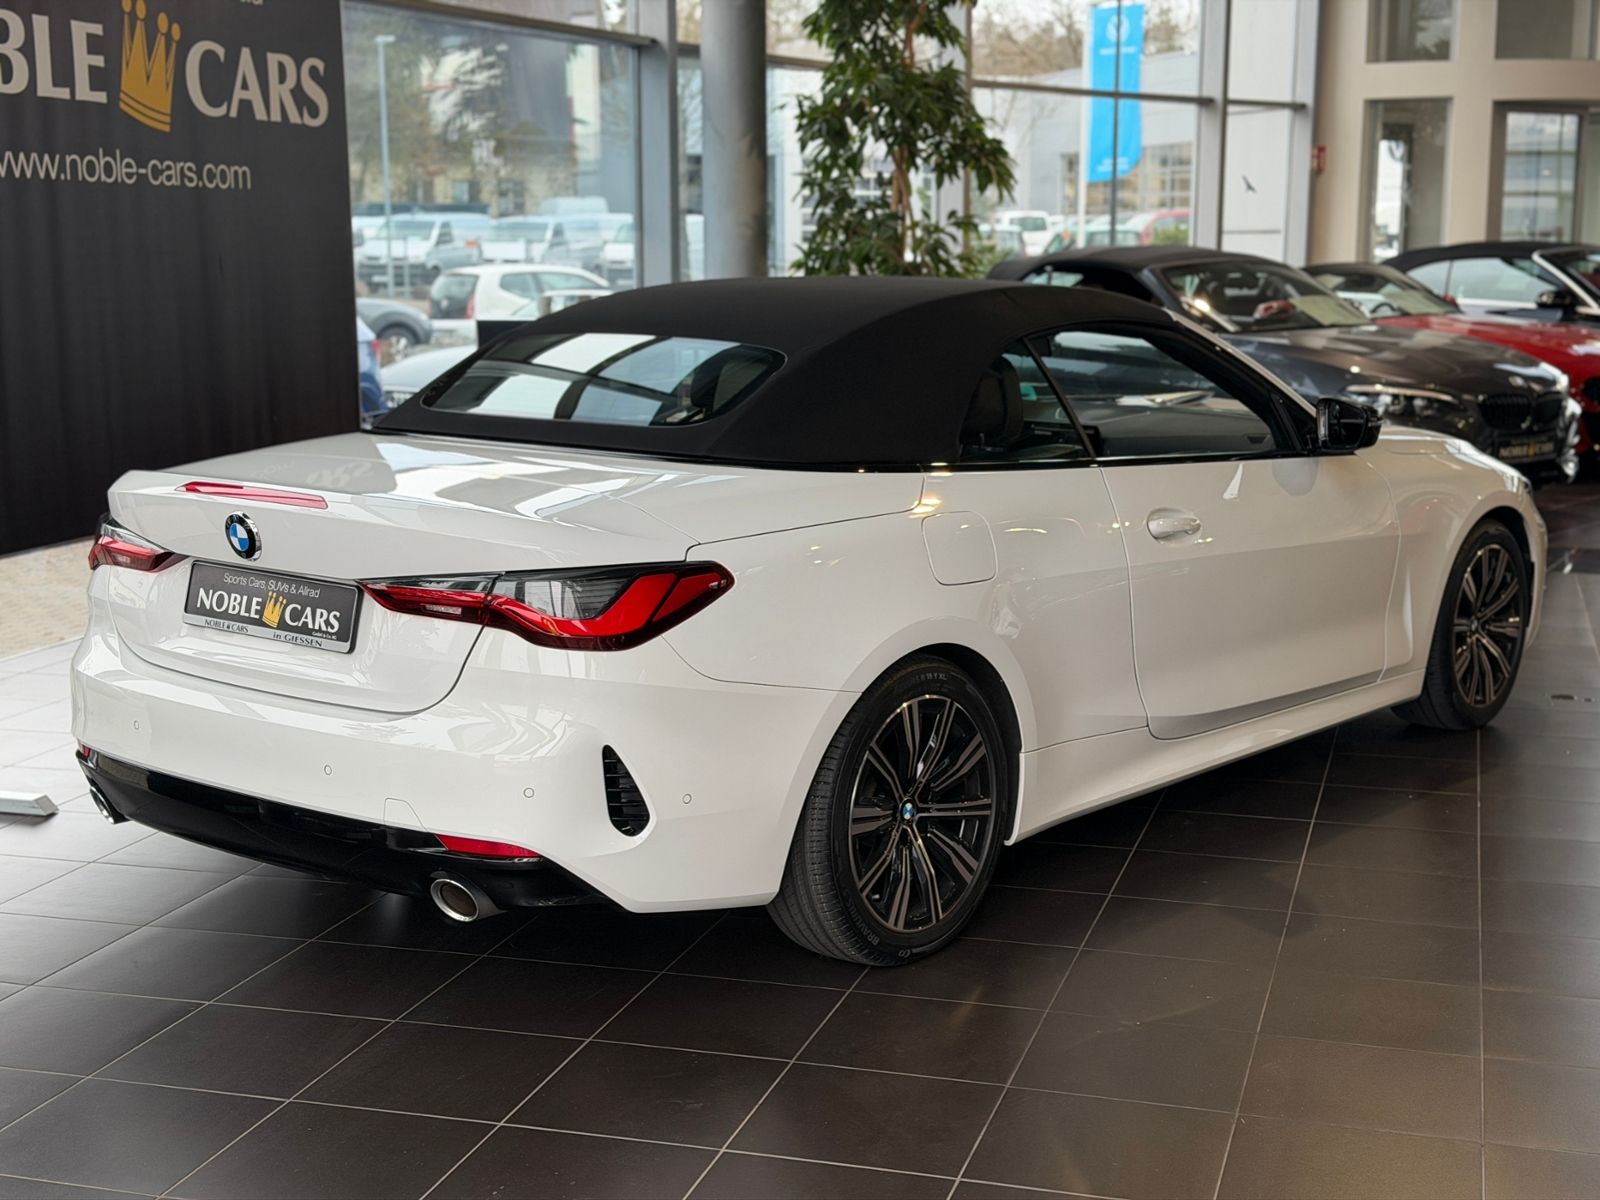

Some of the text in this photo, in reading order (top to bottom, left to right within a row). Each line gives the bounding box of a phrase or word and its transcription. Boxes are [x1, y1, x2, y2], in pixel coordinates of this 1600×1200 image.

[185, 40, 329, 128] CARS
[223, 572, 321, 598] Sports Cars, SUVs & Allrad
[196, 587, 341, 633] NOBLE CARS
[205, 619, 249, 633] NOBLE CARS
[284, 633, 322, 647] GIESSEN
